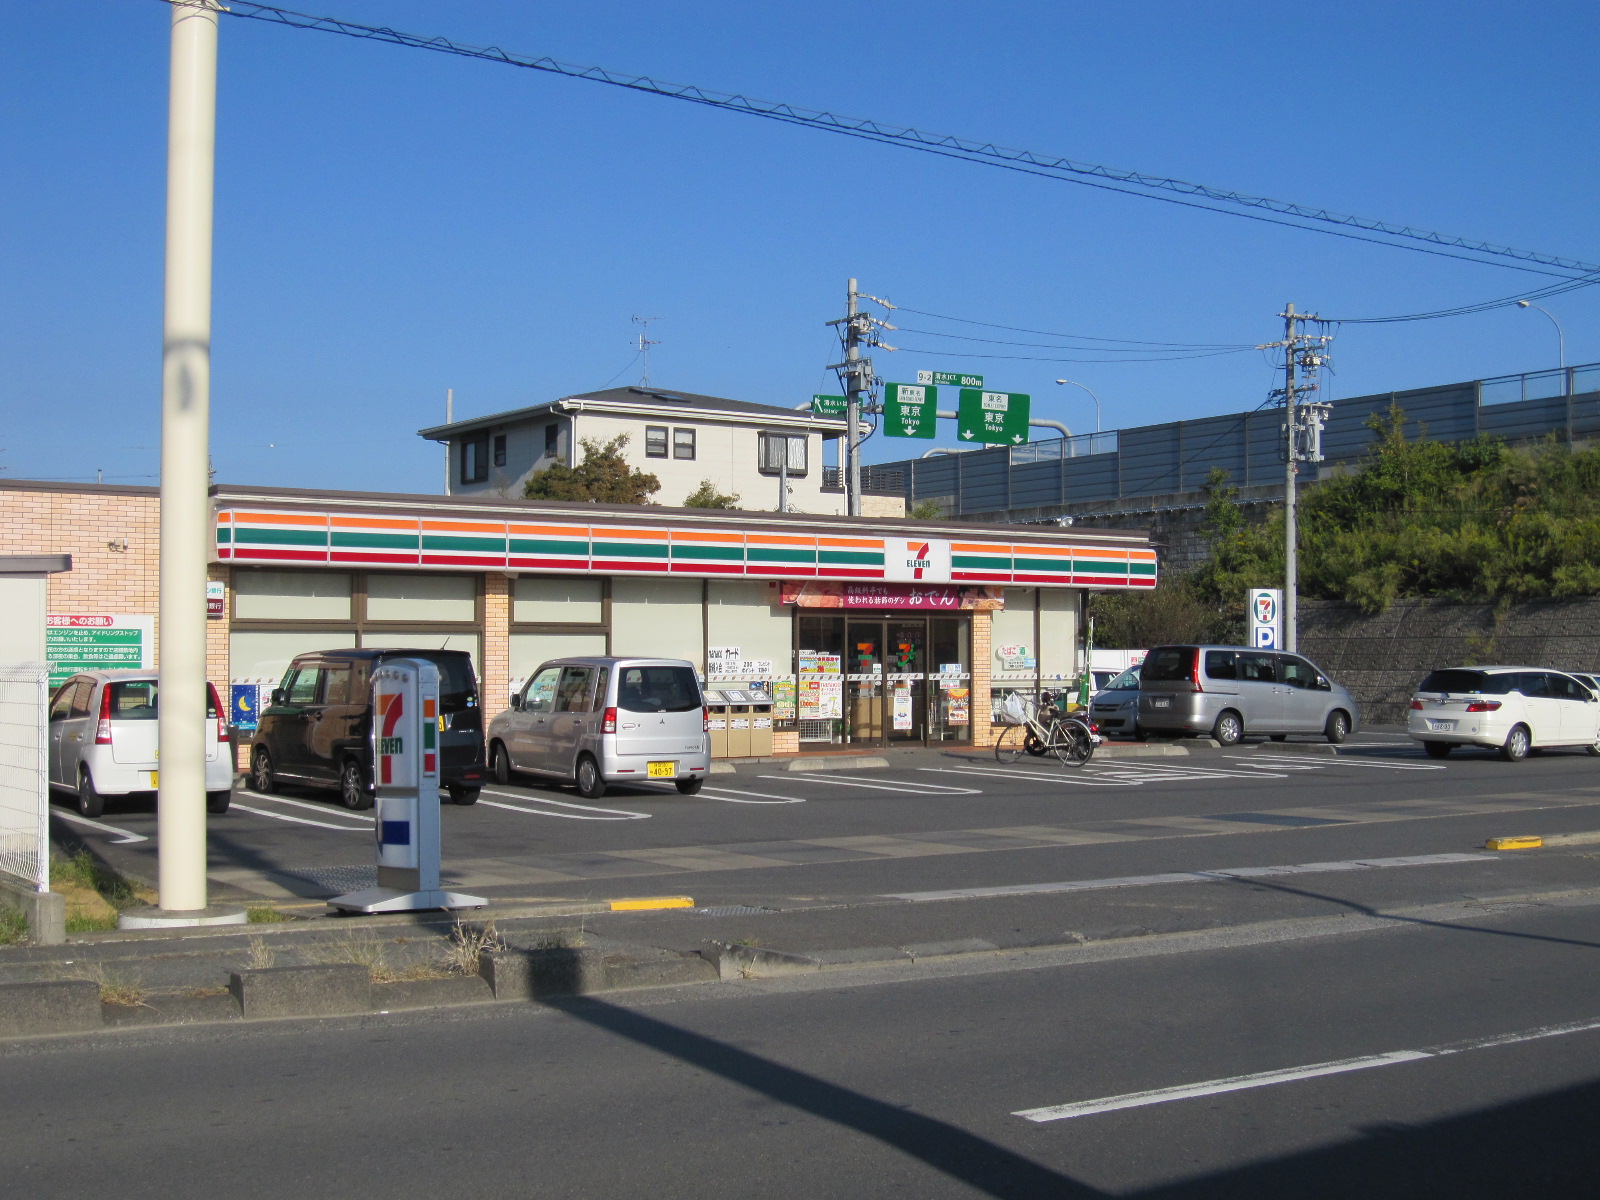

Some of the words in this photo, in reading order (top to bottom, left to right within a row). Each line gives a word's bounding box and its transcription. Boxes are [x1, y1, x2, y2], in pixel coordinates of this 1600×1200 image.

[961, 376, 982, 386] 800m
[988, 394, 1002, 403] 東名
[900, 405, 921, 416] 東京
[901, 418, 920, 426] Tokyo
[984, 412, 1004, 423] 東京
[985, 424, 1003, 432] Tokyo
[907, 542, 929, 579] 7
[909, 588, 954, 606] おでん
[1257, 627, 1273, 648] P
[725, 647, 739, 659] カード
[375, 692, 403, 784] 7
